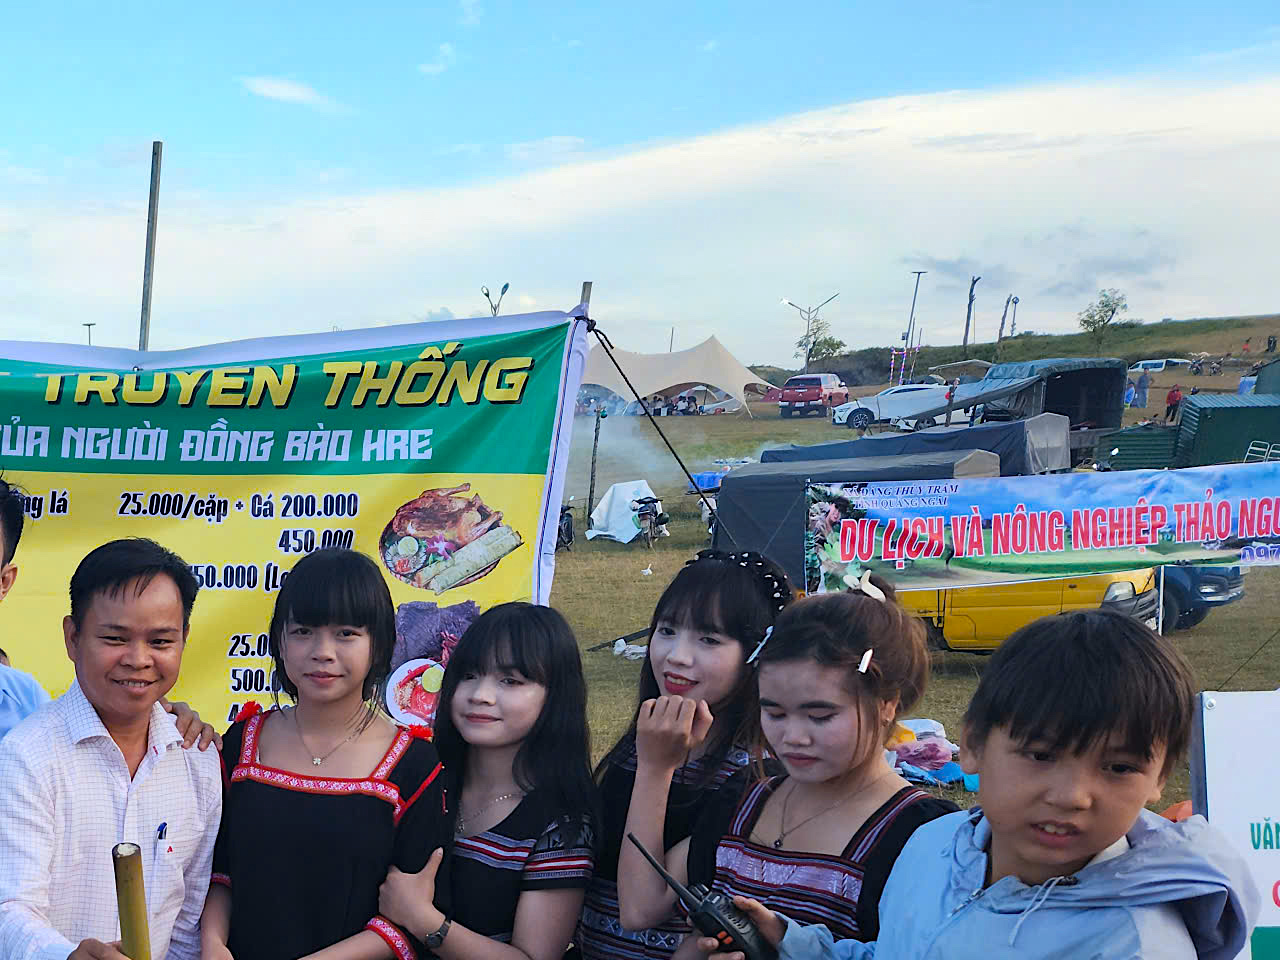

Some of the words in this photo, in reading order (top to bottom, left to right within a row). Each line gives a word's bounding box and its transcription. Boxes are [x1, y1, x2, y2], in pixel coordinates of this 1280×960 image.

[323, 342, 534, 408] THỐNG
[61, 421, 168, 461] NGƯỜI
[179, 418, 274, 462] ĐỒNG
[283, 423, 352, 461] BÀO
[362, 429, 433, 461] HRE
[49, 490, 68, 514] lá
[119, 493, 228, 522] 25.000/cặp
[251, 493, 274, 517] Cá
[280, 493, 359, 517] 200.000
[840, 518, 879, 562] DU
[882, 516, 945, 569] LỊCH
[951, 505, 985, 558] VÀ
[991, 503, 1064, 555] NÔNG
[1072, 497, 1167, 553] NGHIỆP
[1173, 487, 1232, 543] THẢO
[191, 565, 257, 588] 50.000
[229, 634, 273, 657] 25.0
